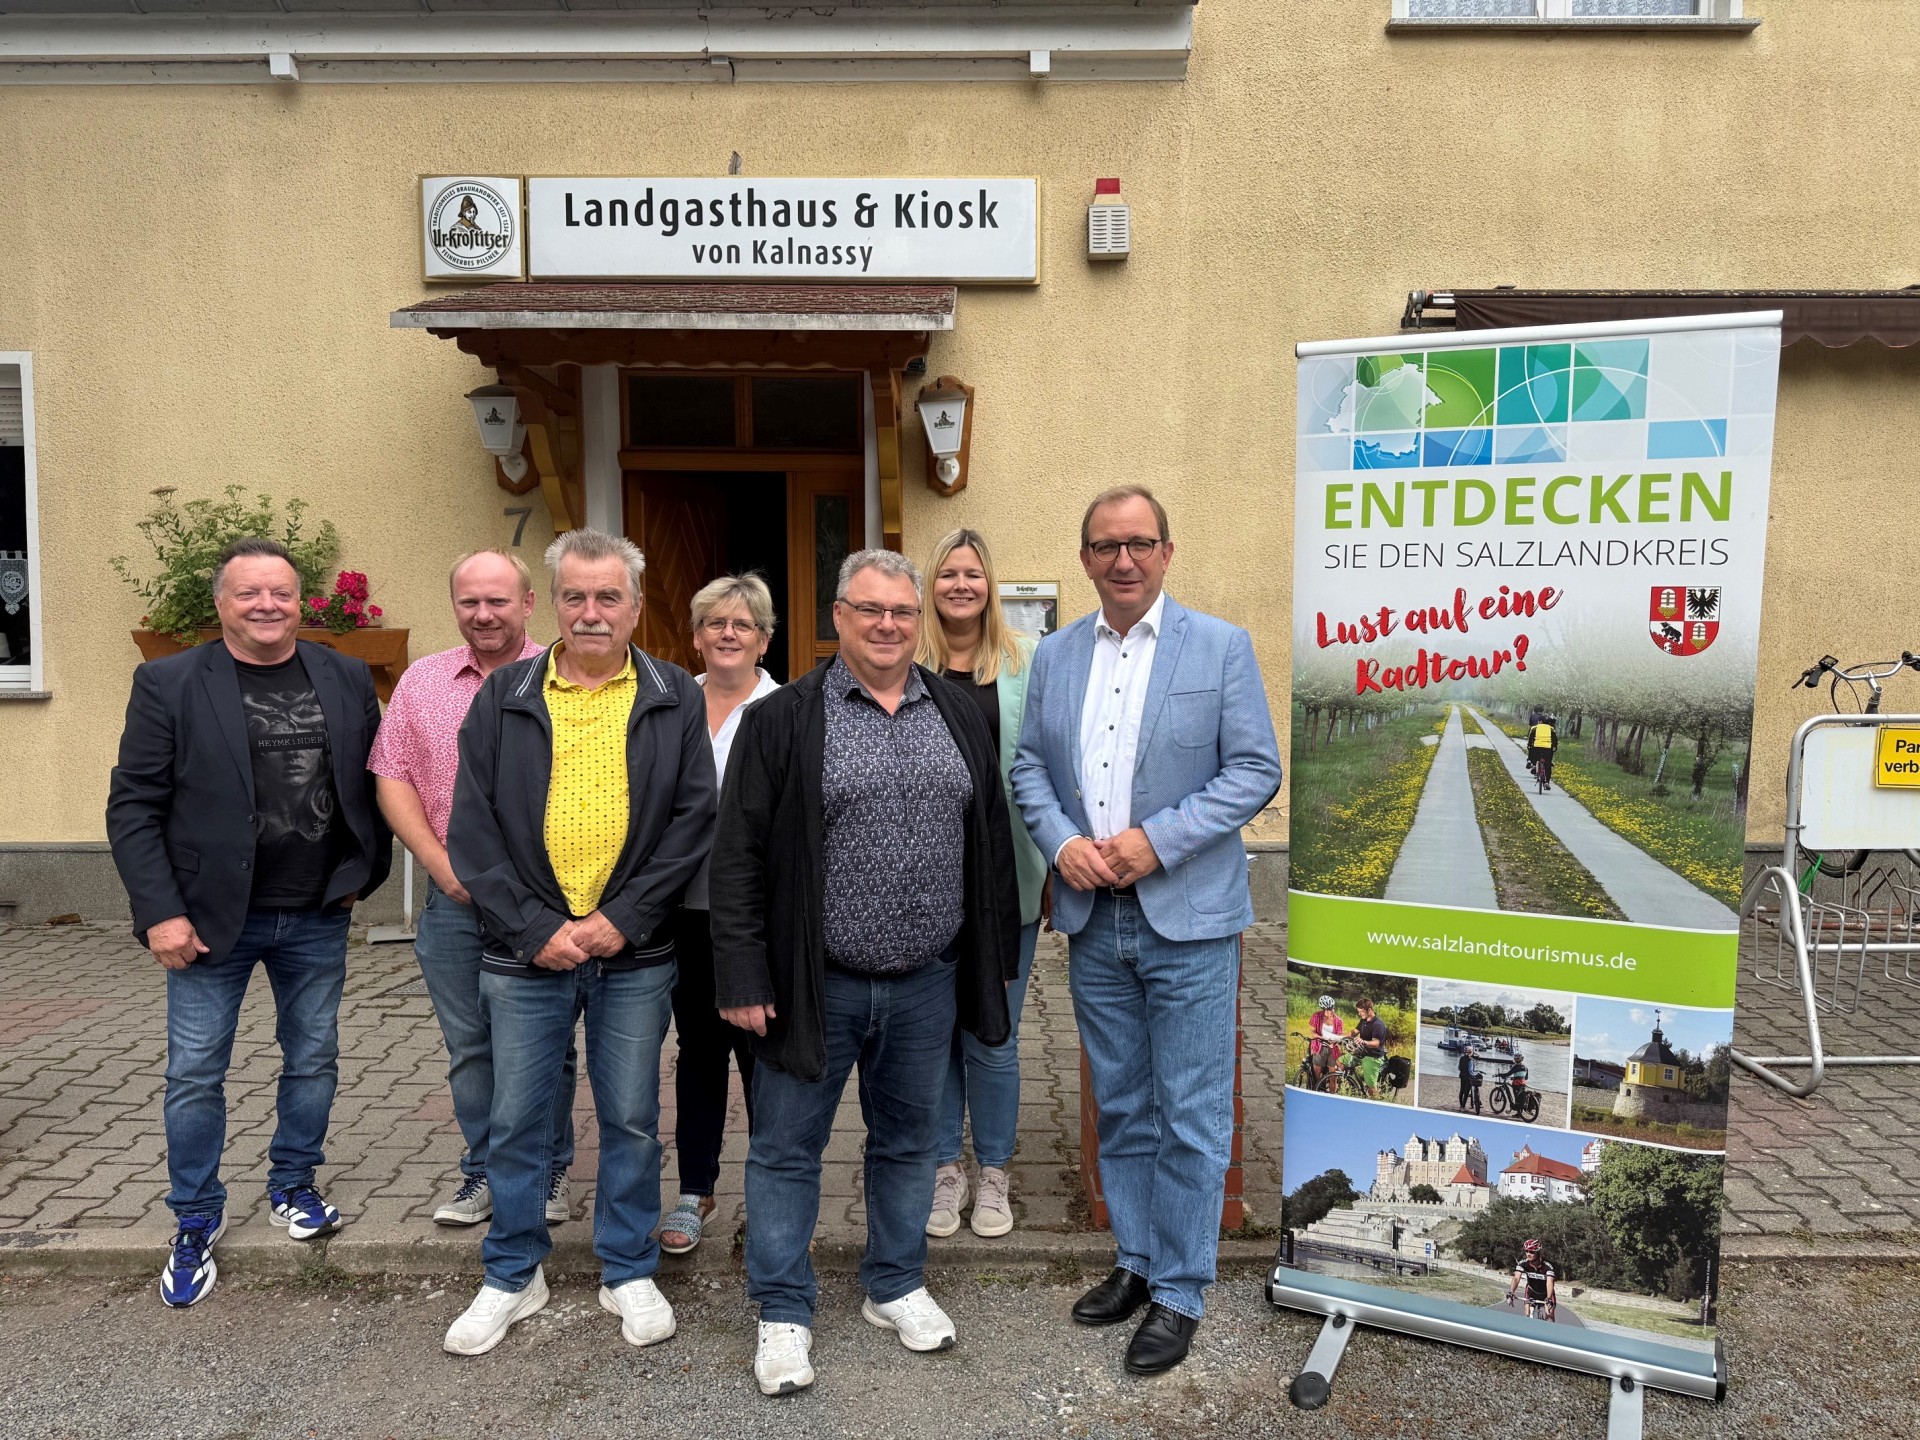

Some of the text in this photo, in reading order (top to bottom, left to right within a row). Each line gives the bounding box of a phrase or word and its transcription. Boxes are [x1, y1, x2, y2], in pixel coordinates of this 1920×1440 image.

[432, 188, 456, 227] TRADITIONELLES
[456, 186, 501, 207] BRAUHANDWERK
[498, 206, 507, 218] SEIT
[565, 187, 999, 237] Landgasthaus & Kiosk
[441, 249, 500, 267] FEINHERBES PILSNER
[692, 237, 873, 272] von Kalnassy
[1324, 471, 1732, 530] ENTDECKEN
[503, 506, 532, 546] 7
[1324, 538, 1729, 569] SIE DEN SALZLANDKREIS
[1316, 585, 1564, 648] Lust auf eine
[1356, 634, 1529, 695] Radtour?
[1366, 931, 1637, 971] www.salzlandtourismus.de
